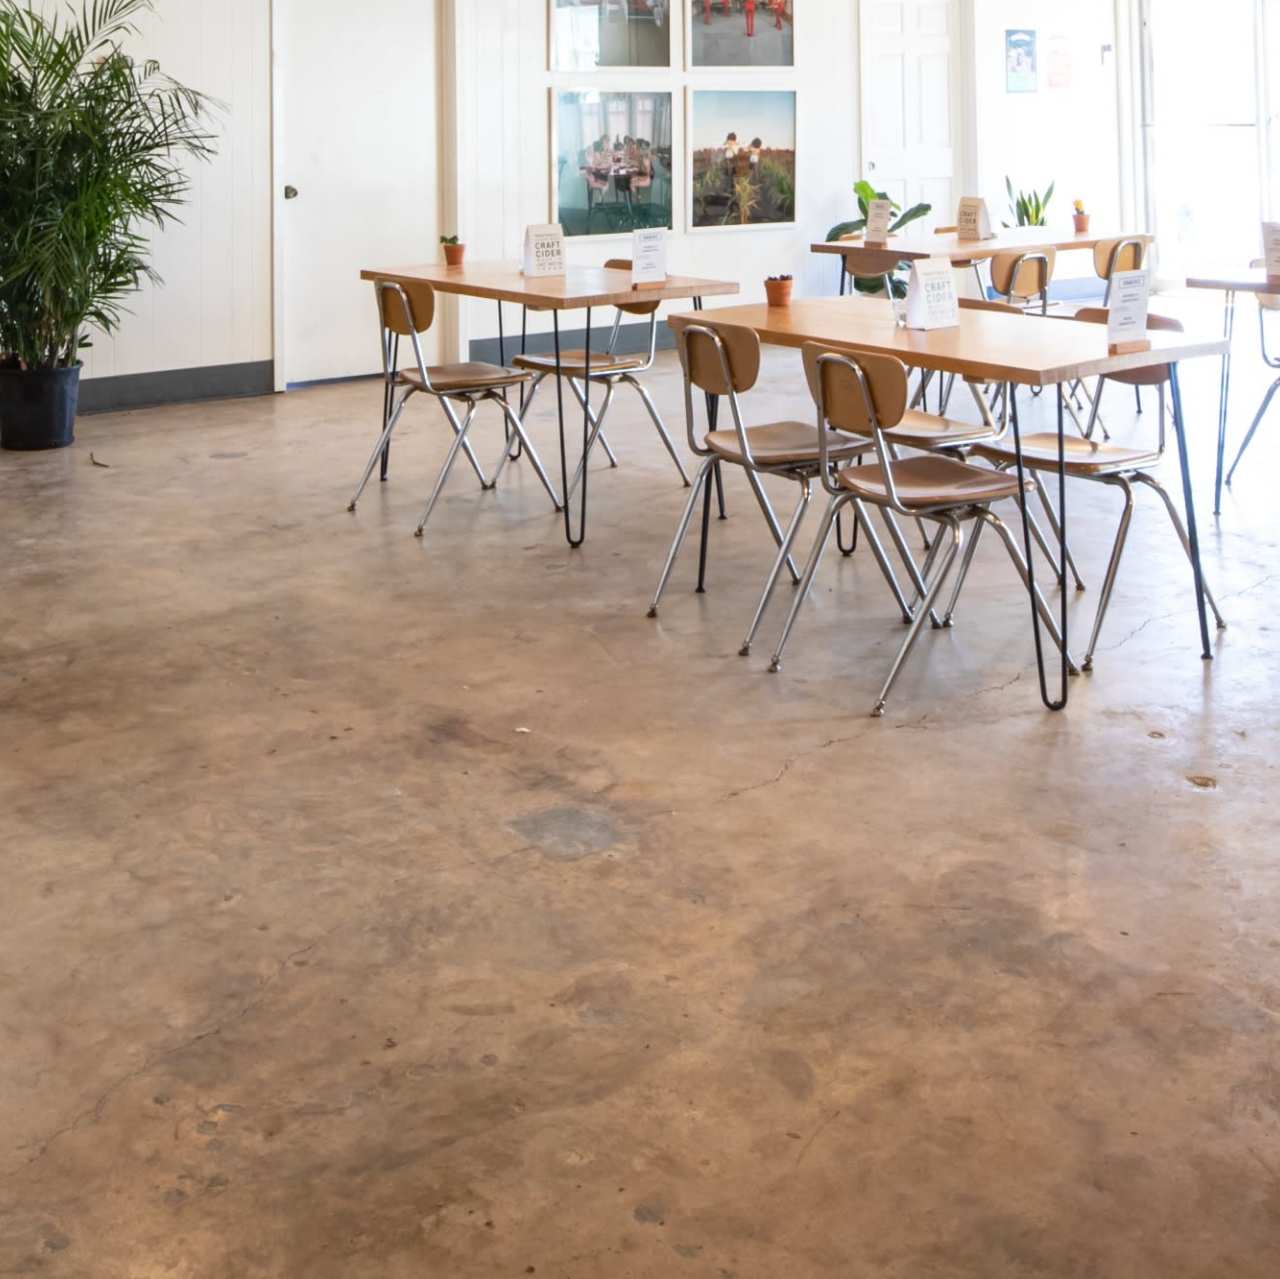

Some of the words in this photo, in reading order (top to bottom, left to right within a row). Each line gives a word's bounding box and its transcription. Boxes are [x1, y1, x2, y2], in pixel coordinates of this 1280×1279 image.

[535, 240, 560, 250] CRAFT
[536, 249, 561, 258] CIDER
[925, 280, 951, 293] CRAFT
